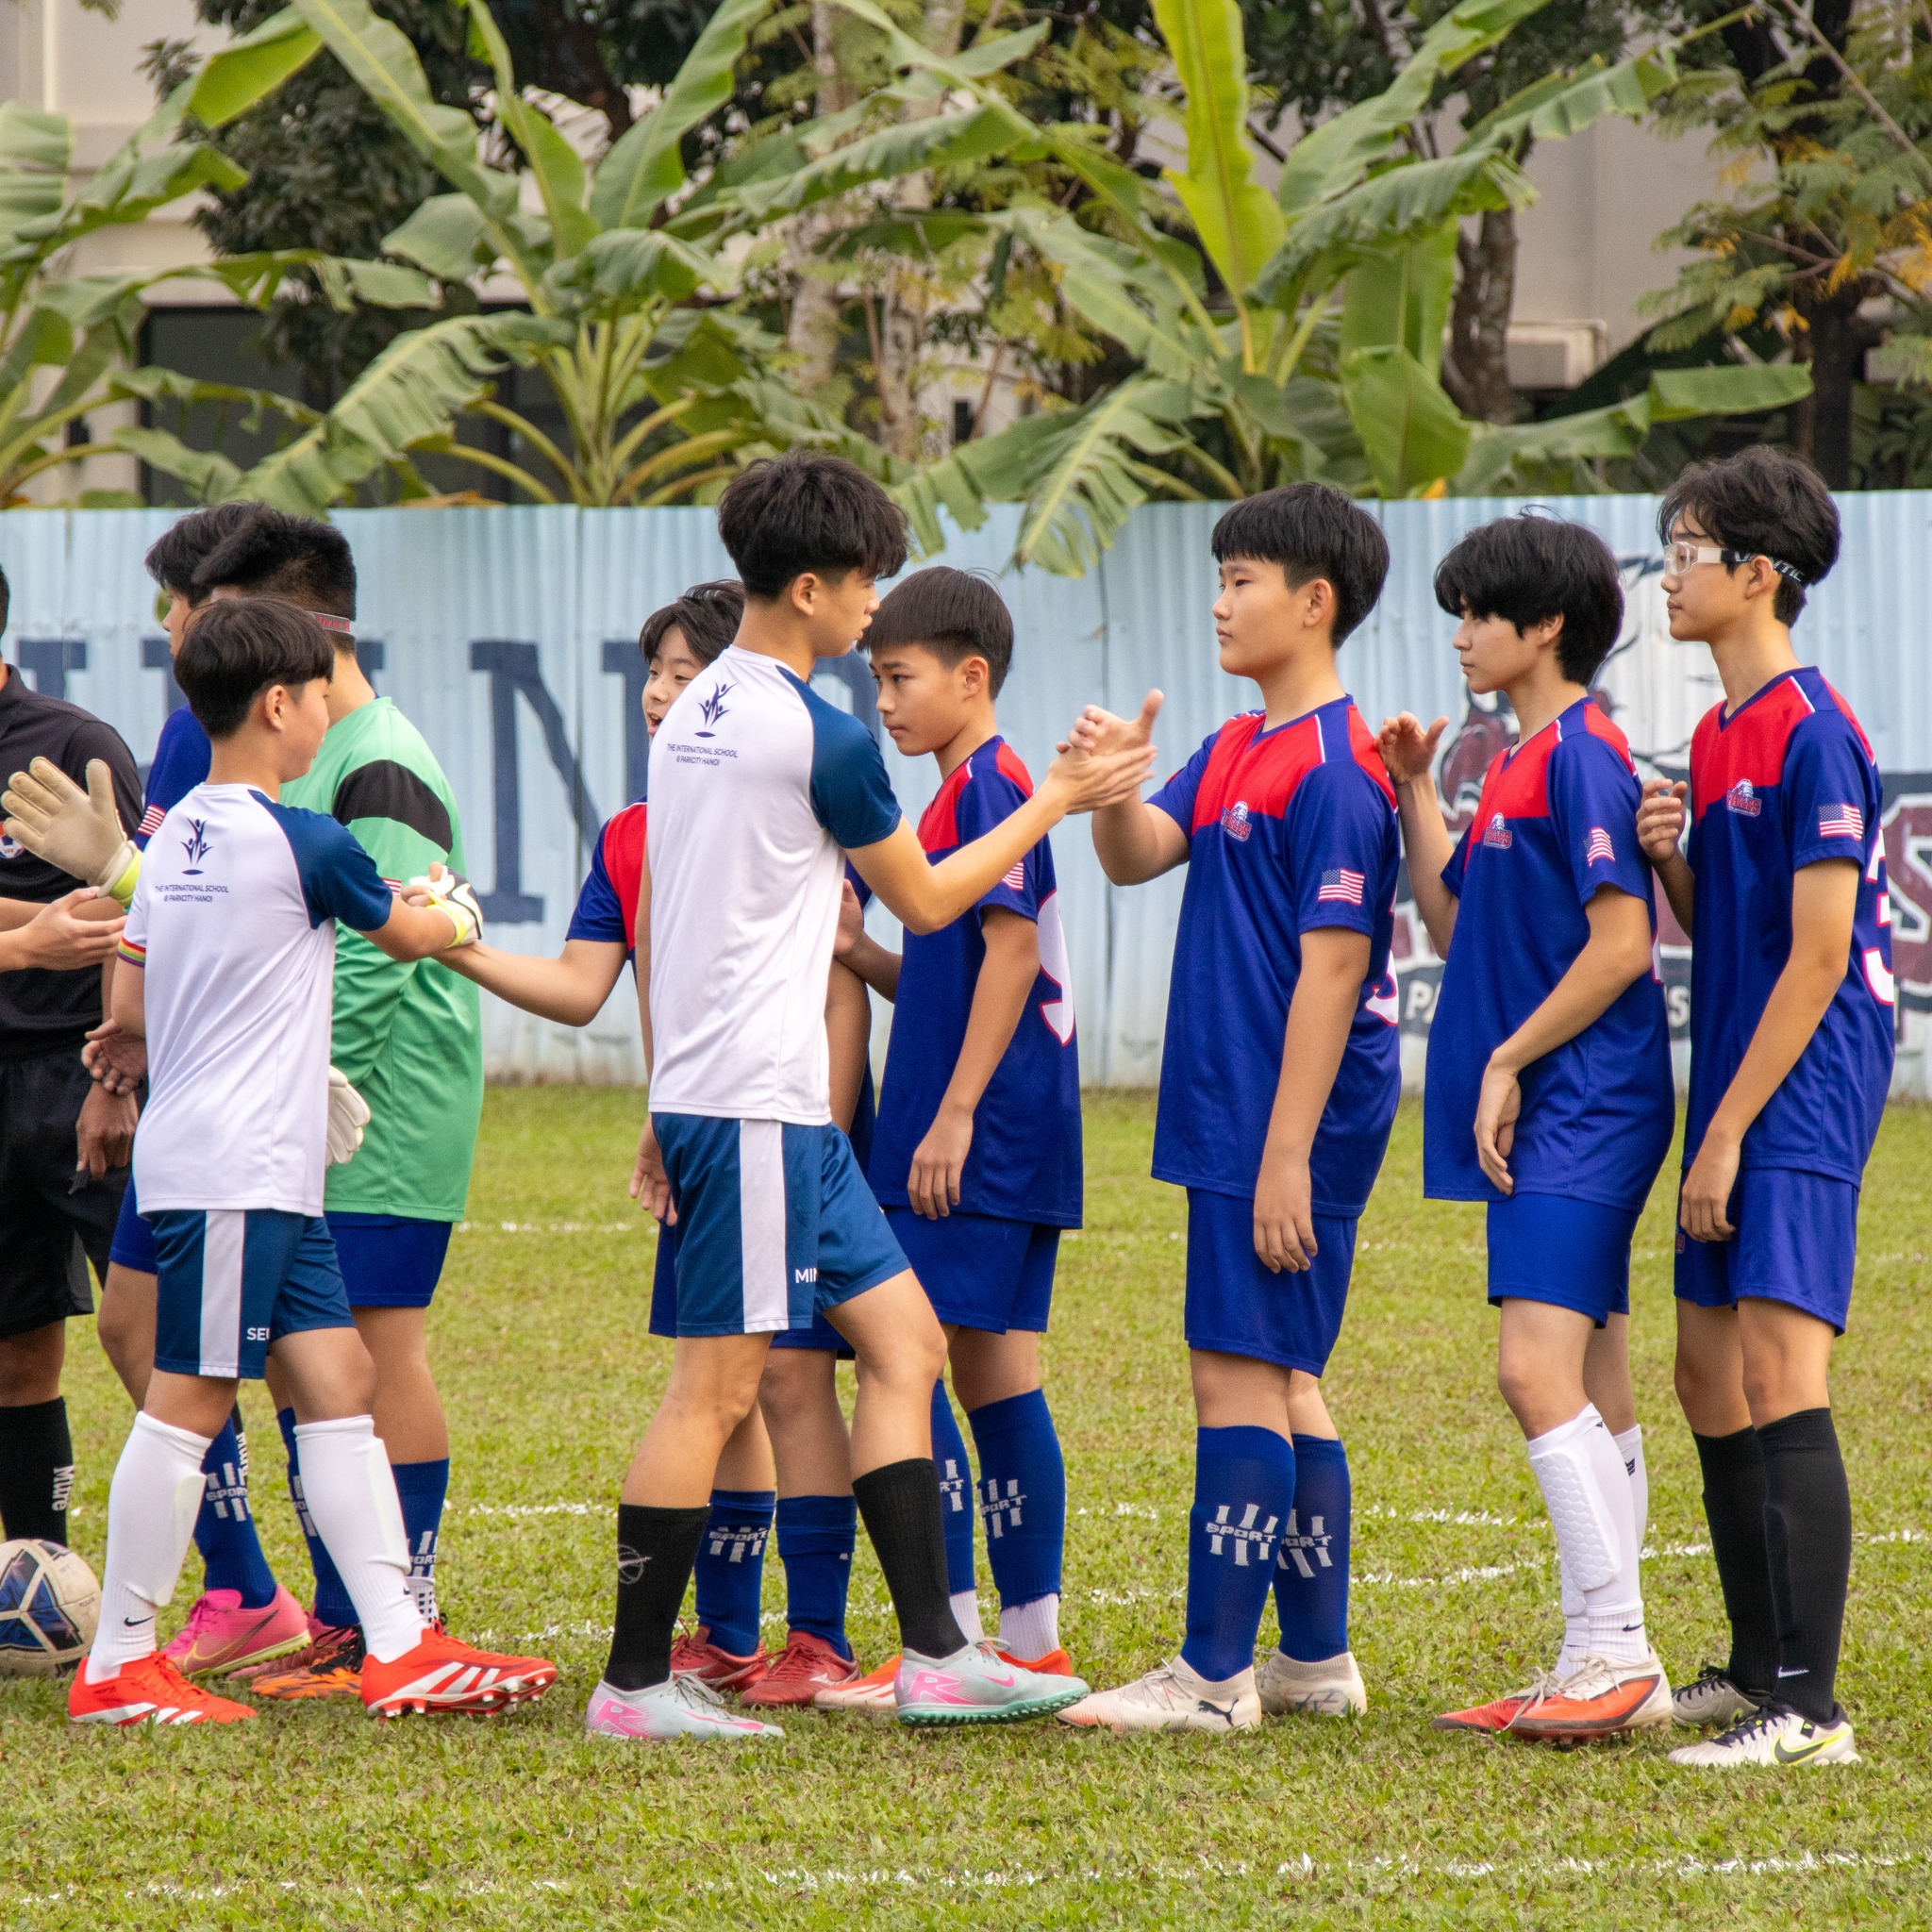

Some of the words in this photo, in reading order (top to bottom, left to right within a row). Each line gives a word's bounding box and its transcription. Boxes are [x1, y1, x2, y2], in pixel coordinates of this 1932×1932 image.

[676, 744, 713, 755] INTERNATIONAL
[714, 748, 739, 758] SCHOOL
[680, 756, 702, 764] PARKCITY
[205, 885, 229, 893] SCHOOL
[708, 1529, 769, 1541] SPORT
[1206, 1522, 1277, 1543] SPORT
